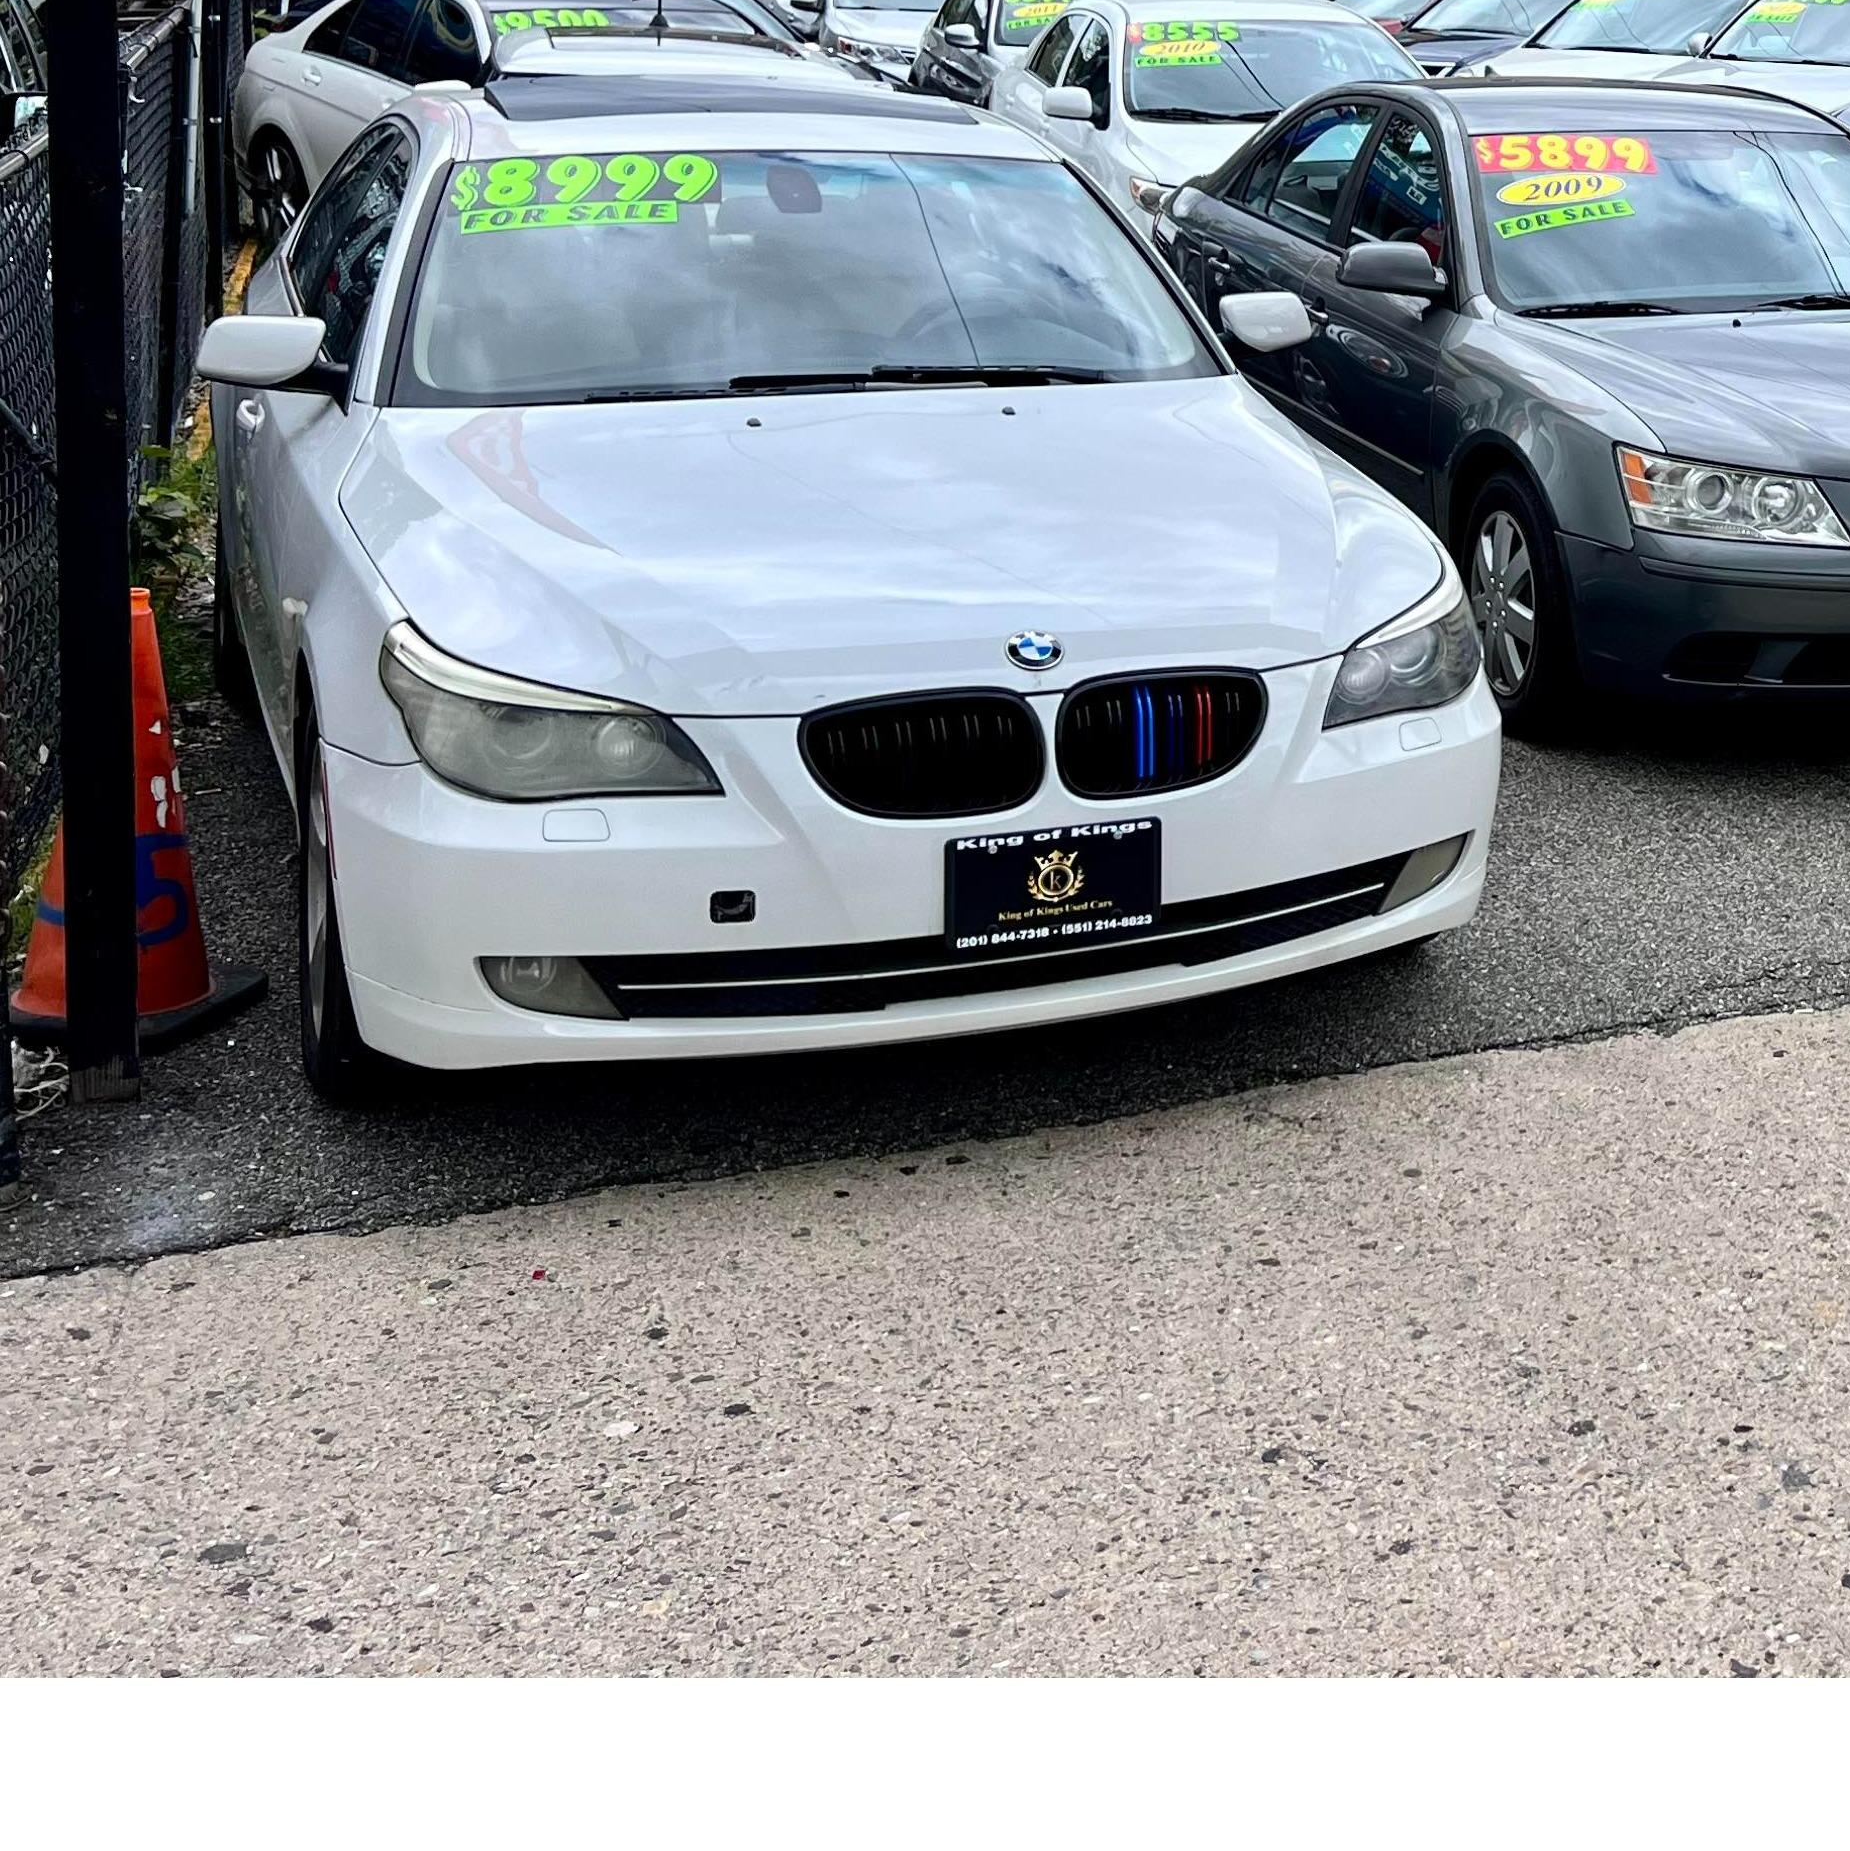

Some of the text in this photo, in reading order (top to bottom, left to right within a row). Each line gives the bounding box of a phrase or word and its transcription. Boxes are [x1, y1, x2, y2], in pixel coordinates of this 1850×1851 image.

[1475, 134, 1650, 173] $5899
[451, 153, 718, 212] $8999
[1523, 176, 1603, 201] 2009
[464, 203, 675, 230] FOR SALE
[1501, 201, 1627, 236] FOR SALE
[957, 820, 1152, 850] King of Kings
[998, 910, 1022, 921] King
[1024, 908, 1034, 918] of
[1036, 905, 1065, 917] Kings
[956, 935, 988, 949] (201)
